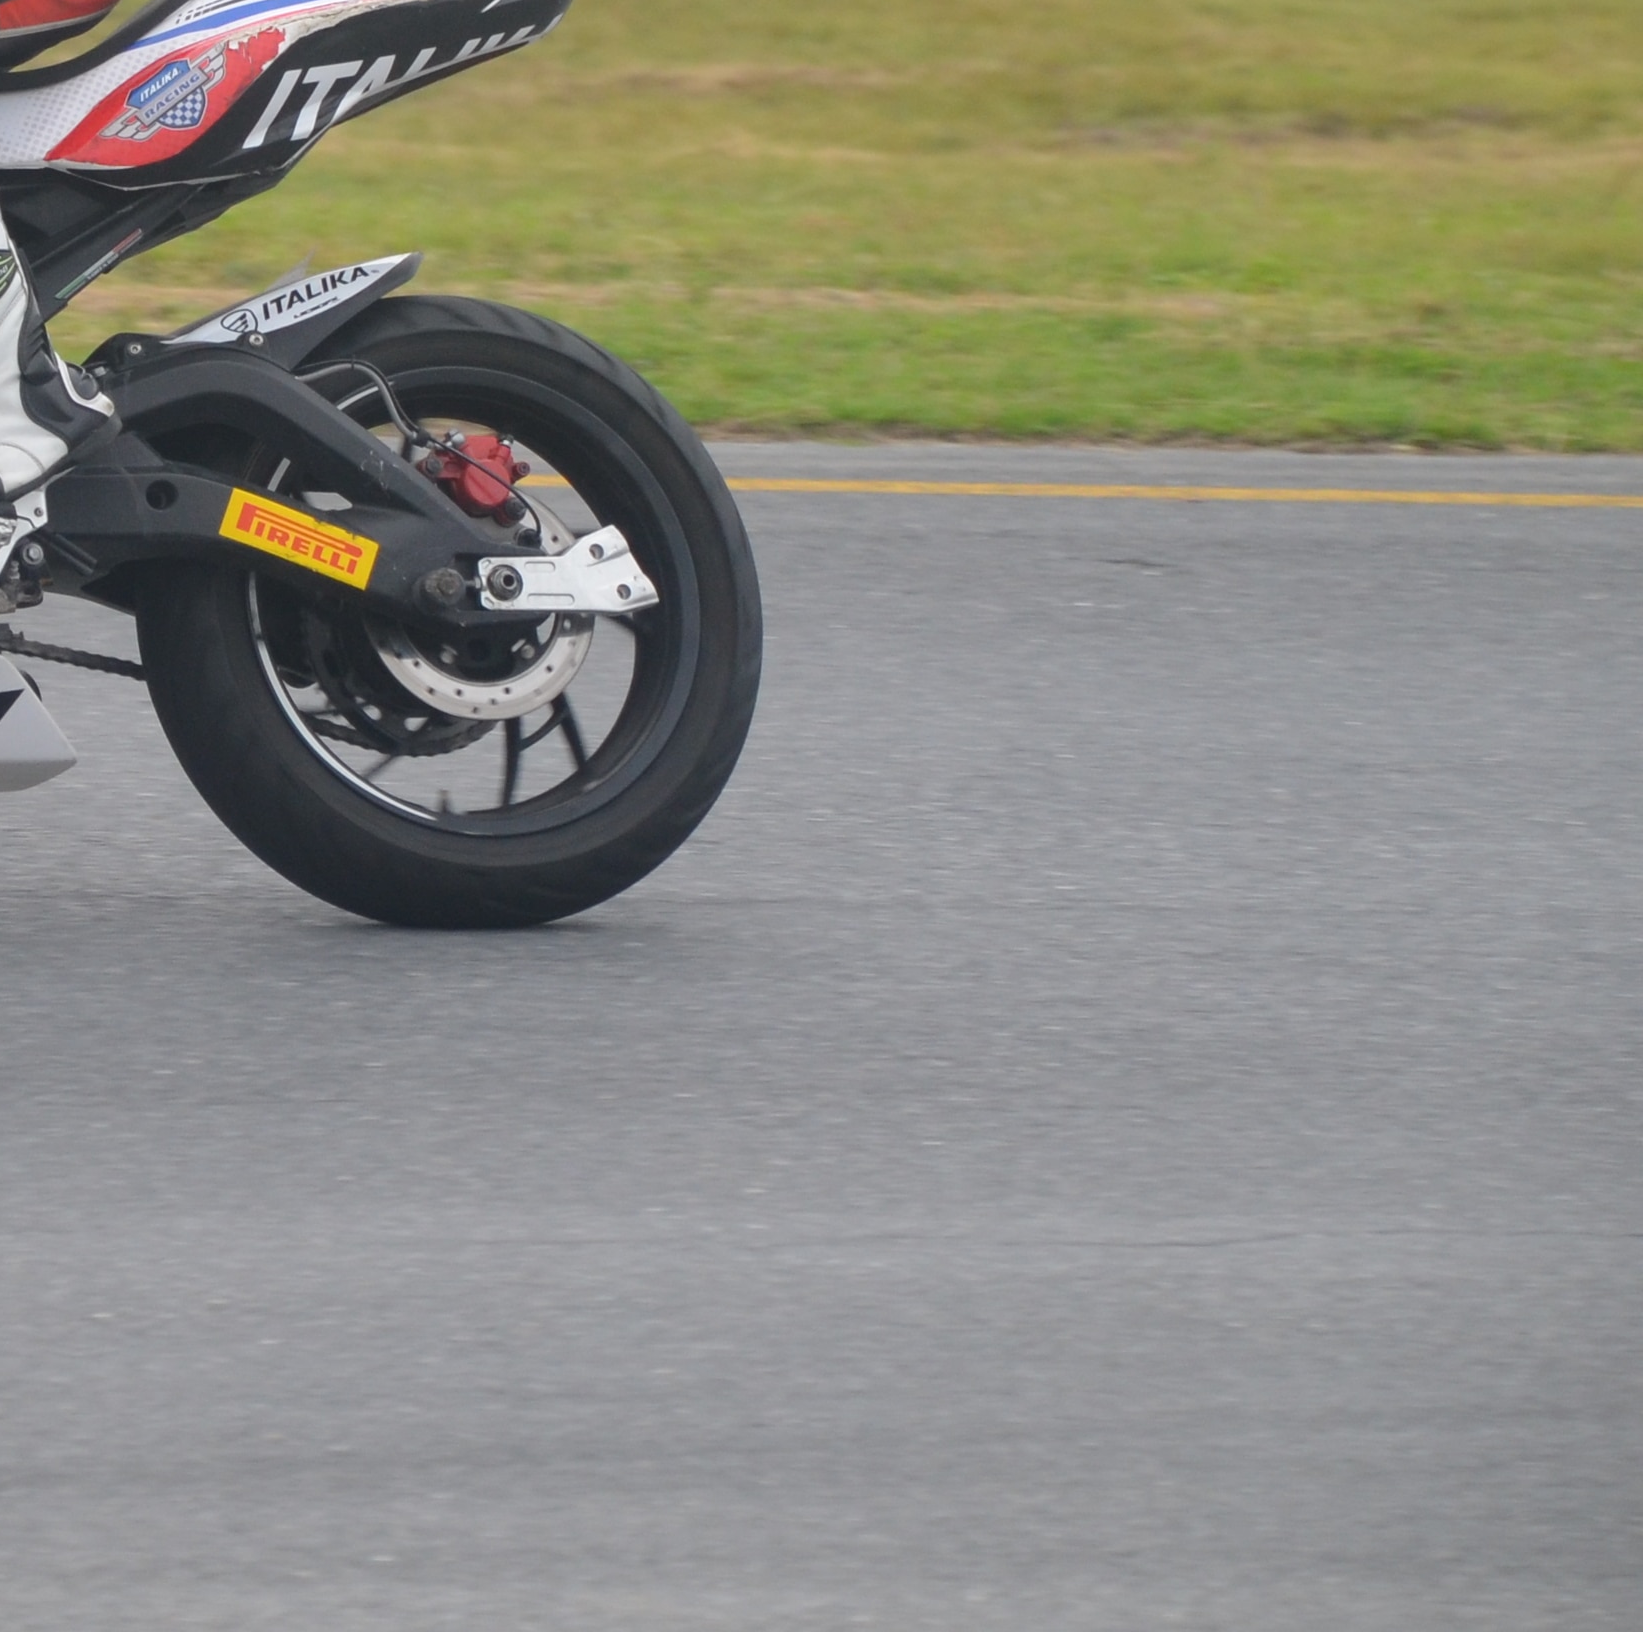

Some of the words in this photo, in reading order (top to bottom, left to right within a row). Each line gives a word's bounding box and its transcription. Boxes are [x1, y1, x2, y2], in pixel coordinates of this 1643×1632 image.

[140, 67, 179, 102] ITALIKA
[144, 73, 200, 118] RACING
[262, 266, 369, 320] ITALIKA
[236, 502, 363, 575] PIRELLI
